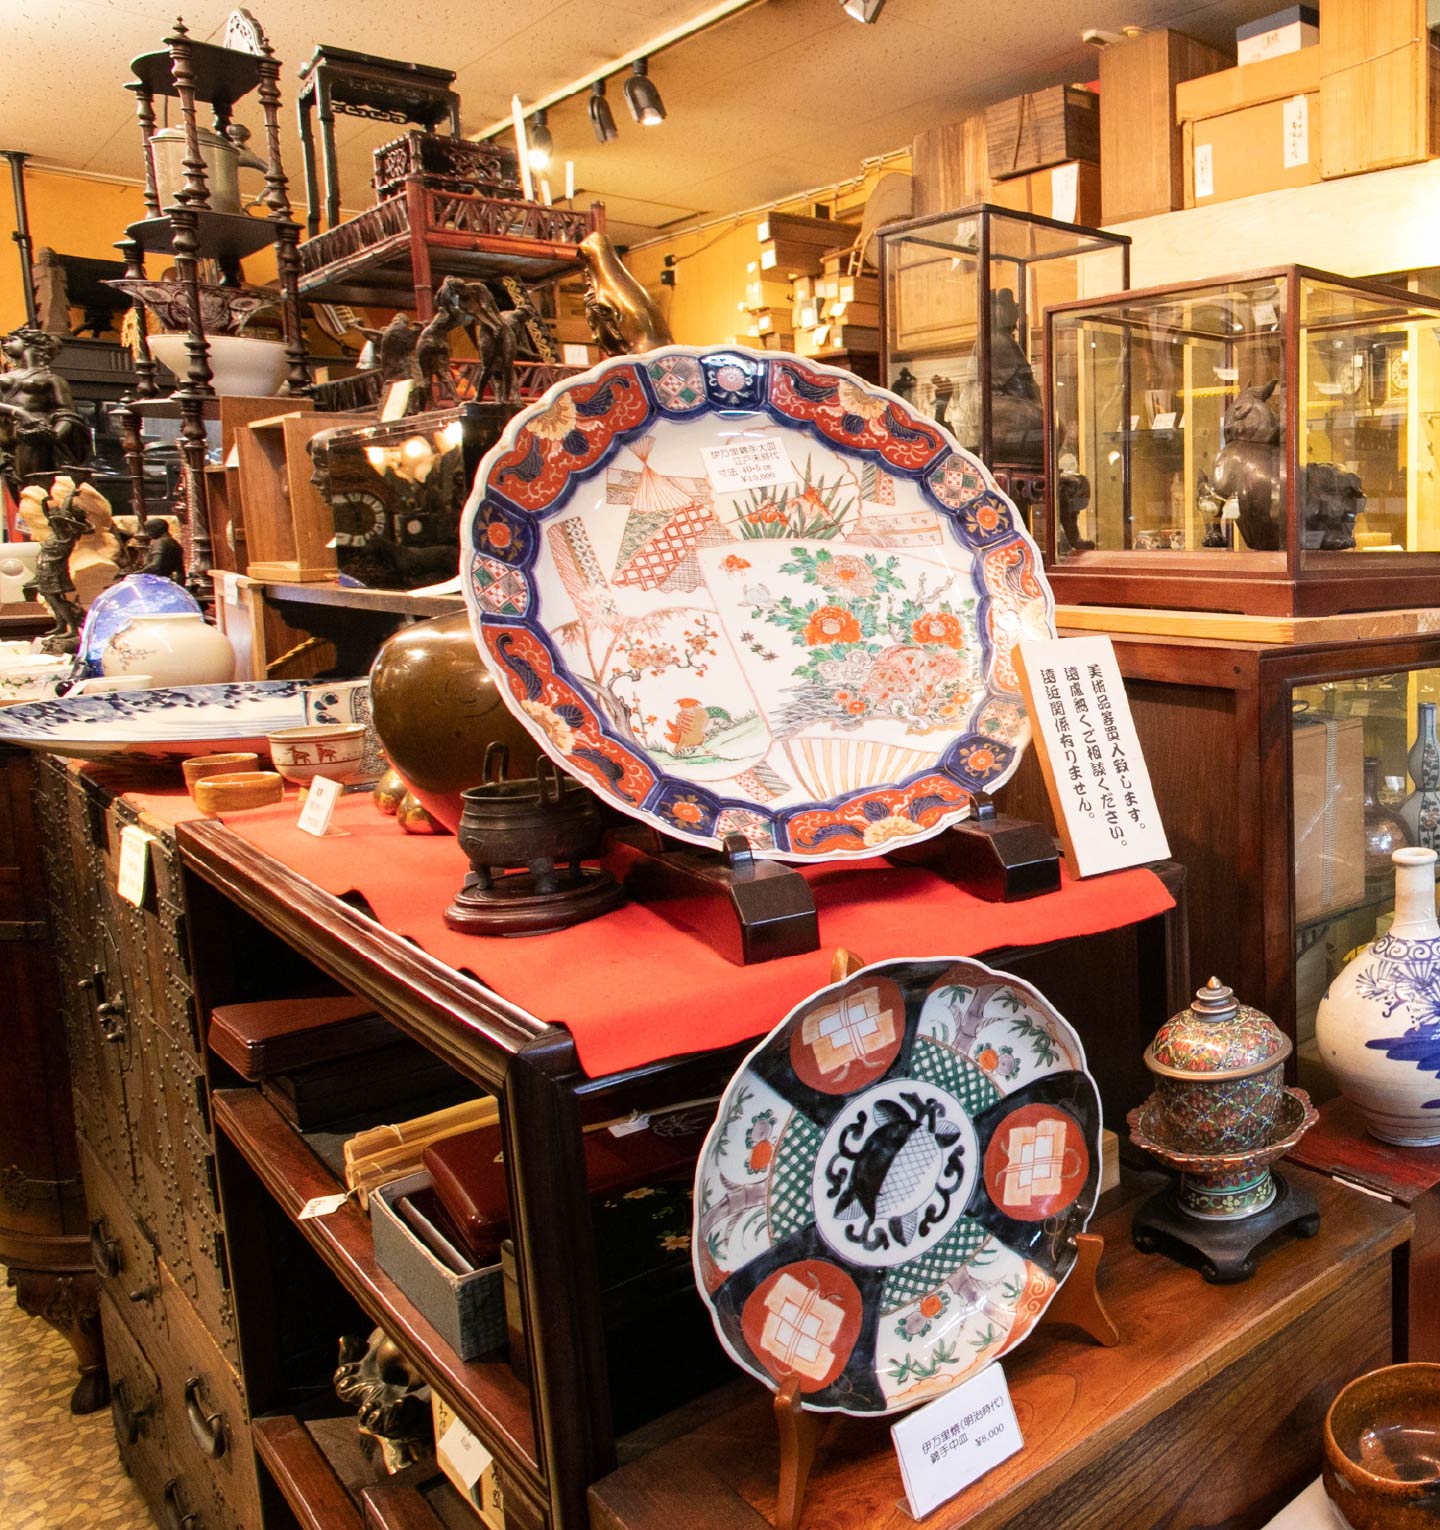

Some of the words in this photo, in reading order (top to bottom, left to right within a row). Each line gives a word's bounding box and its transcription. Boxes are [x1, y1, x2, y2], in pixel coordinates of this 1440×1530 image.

[1040, 668, 1096, 820] 遠近関係有りません。
[1063, 666, 1128, 847] 遠慮無くご相談ください。
[1086, 663, 1147, 831] 美術品等買入致します。
